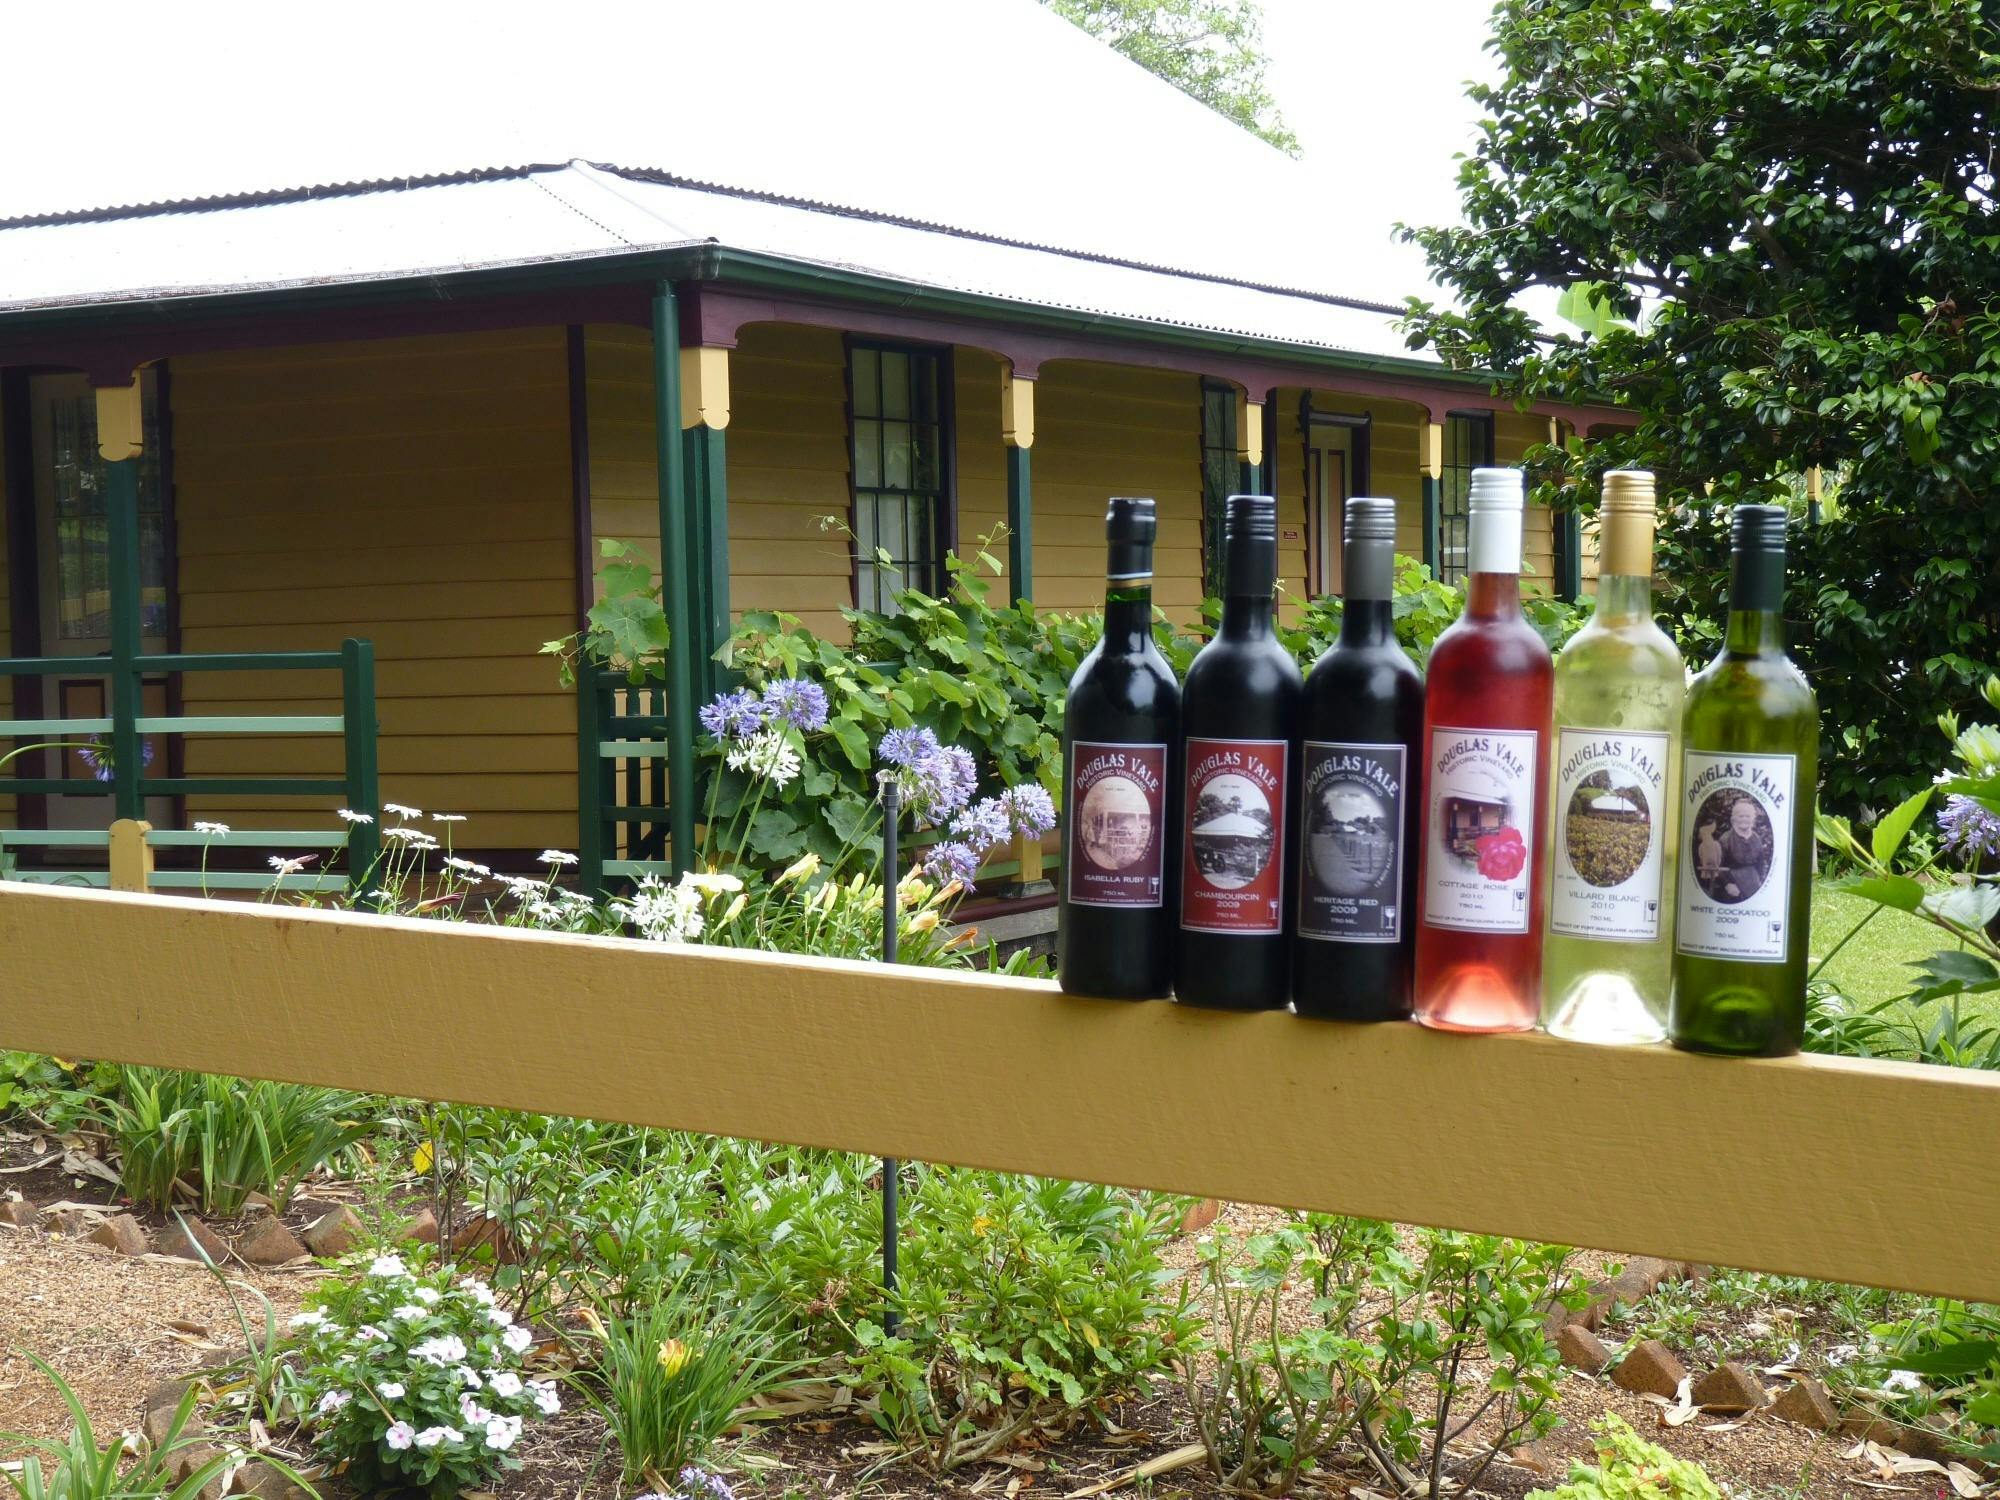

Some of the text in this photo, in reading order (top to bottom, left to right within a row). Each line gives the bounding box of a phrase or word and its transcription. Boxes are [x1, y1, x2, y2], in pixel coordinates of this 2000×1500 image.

[1437, 738, 1524, 778] DOUGLAS VALE
[1562, 741, 1662, 789] DOUGLAS VALE
[1076, 753, 1159, 793] DOUGLAS VALE
[1191, 751, 1278, 791] DOUGLAS VALE
[1305, 755, 1399, 799] DOUGLAS VALE
[1688, 762, 1785, 809] DOUGLAS VALE
[1084, 874, 1121, 883] ISABELLA
[1438, 880, 1478, 890] COTTAGE
[1194, 891, 1260, 901] CHAMBOURCIN
[1313, 896, 1379, 906] HERITAGE RED
[1568, 890, 1640, 903] VILLARD BLANC
[1216, 900, 1240, 908] 2009
[1330, 905, 1358, 914] 2009
[1591, 902, 1615, 910] 2010
[1690, 905, 1770, 918] WHITE COCKATOO
[1716, 916, 1740, 924] 2009
